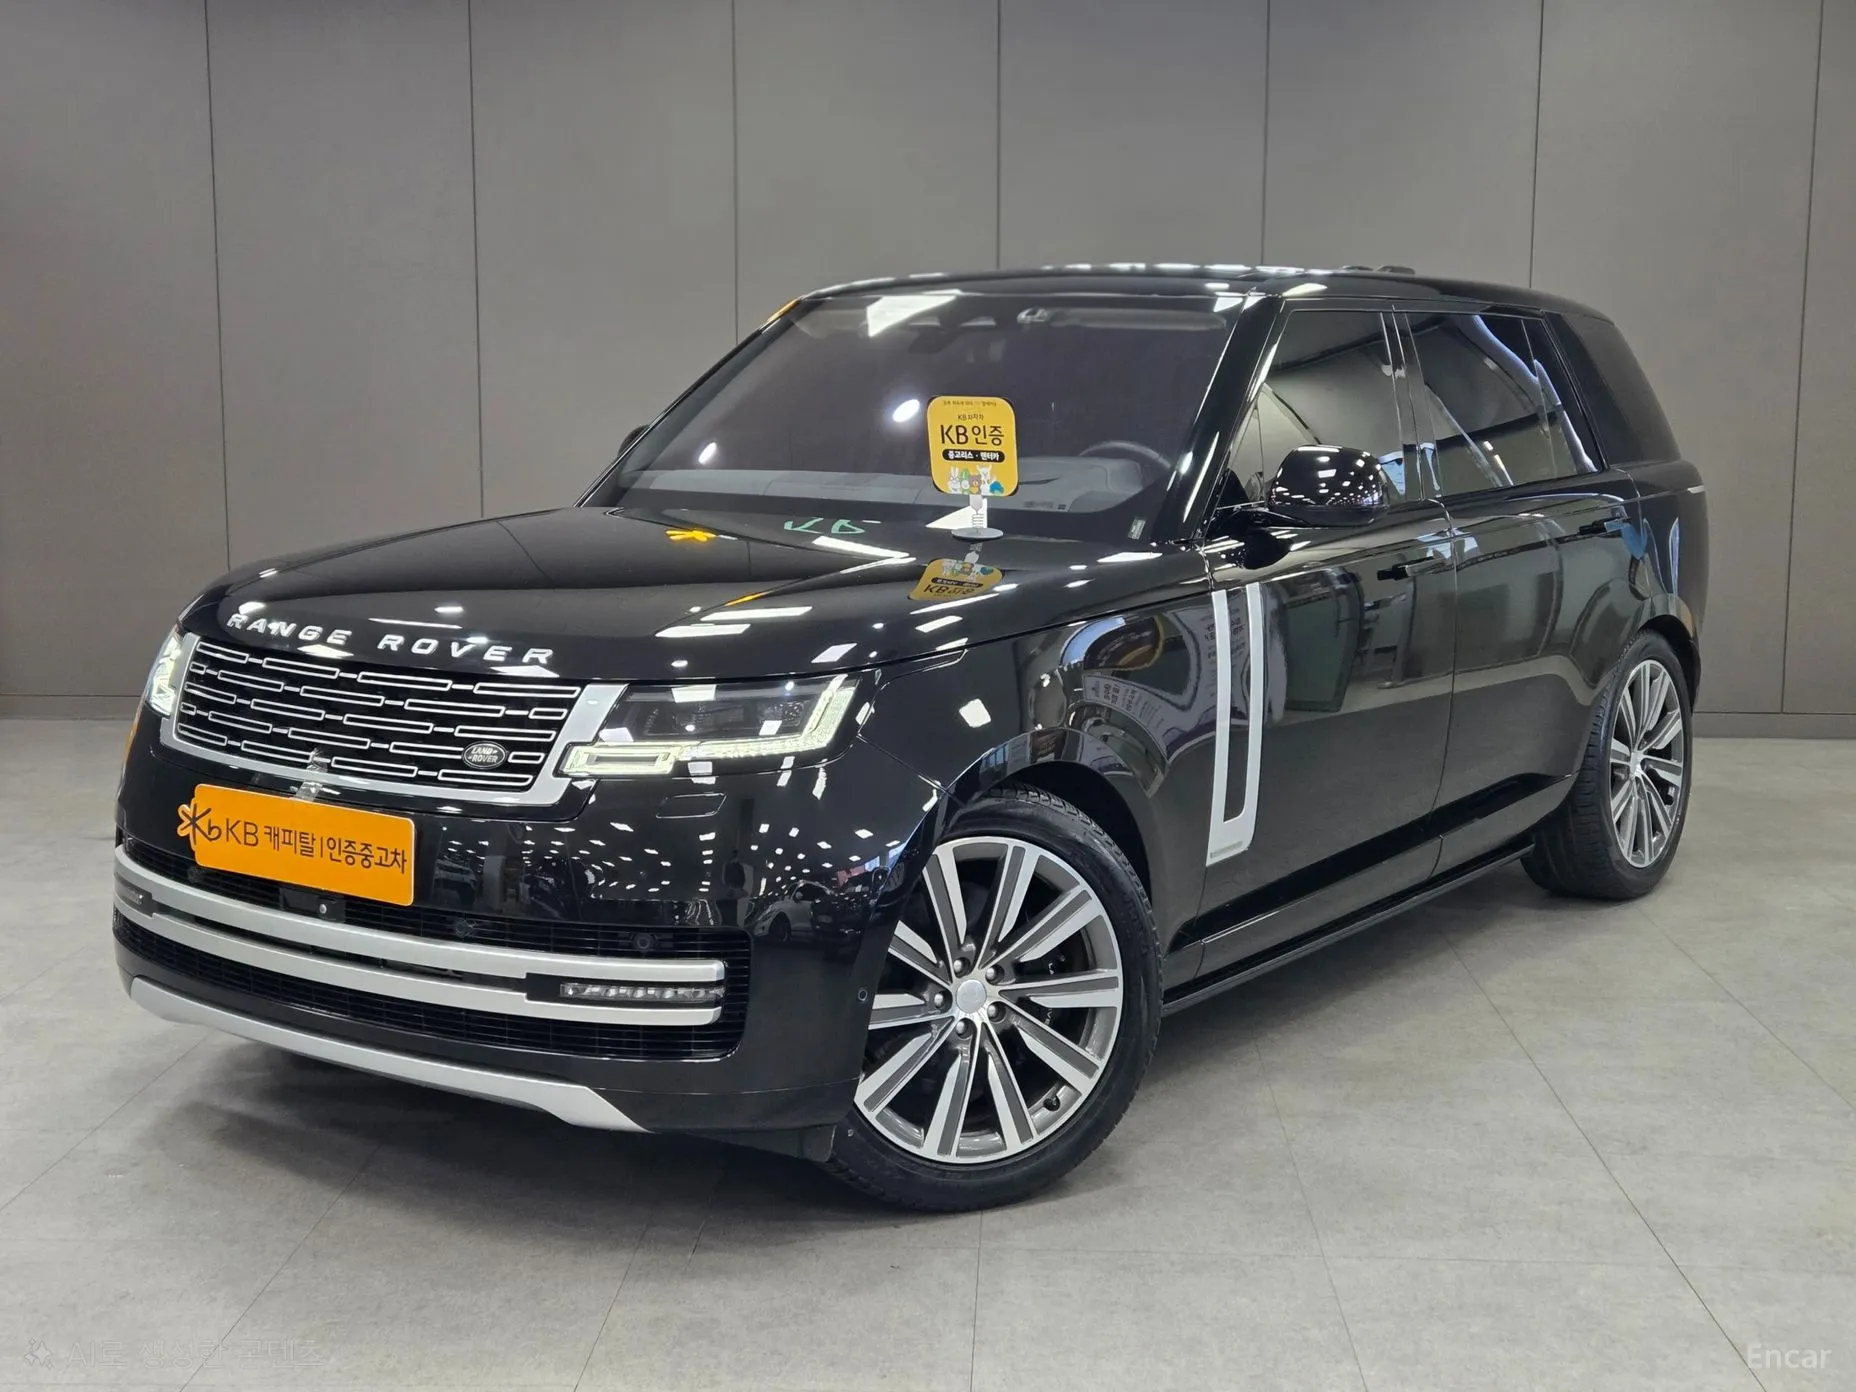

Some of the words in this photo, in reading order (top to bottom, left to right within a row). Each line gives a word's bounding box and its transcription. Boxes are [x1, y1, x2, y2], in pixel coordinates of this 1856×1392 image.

[226, 613, 353, 645] RANGE
[377, 634, 555, 664] ROVER
[471, 746, 493, 755] LAND
[471, 754, 498, 763] ROVER
